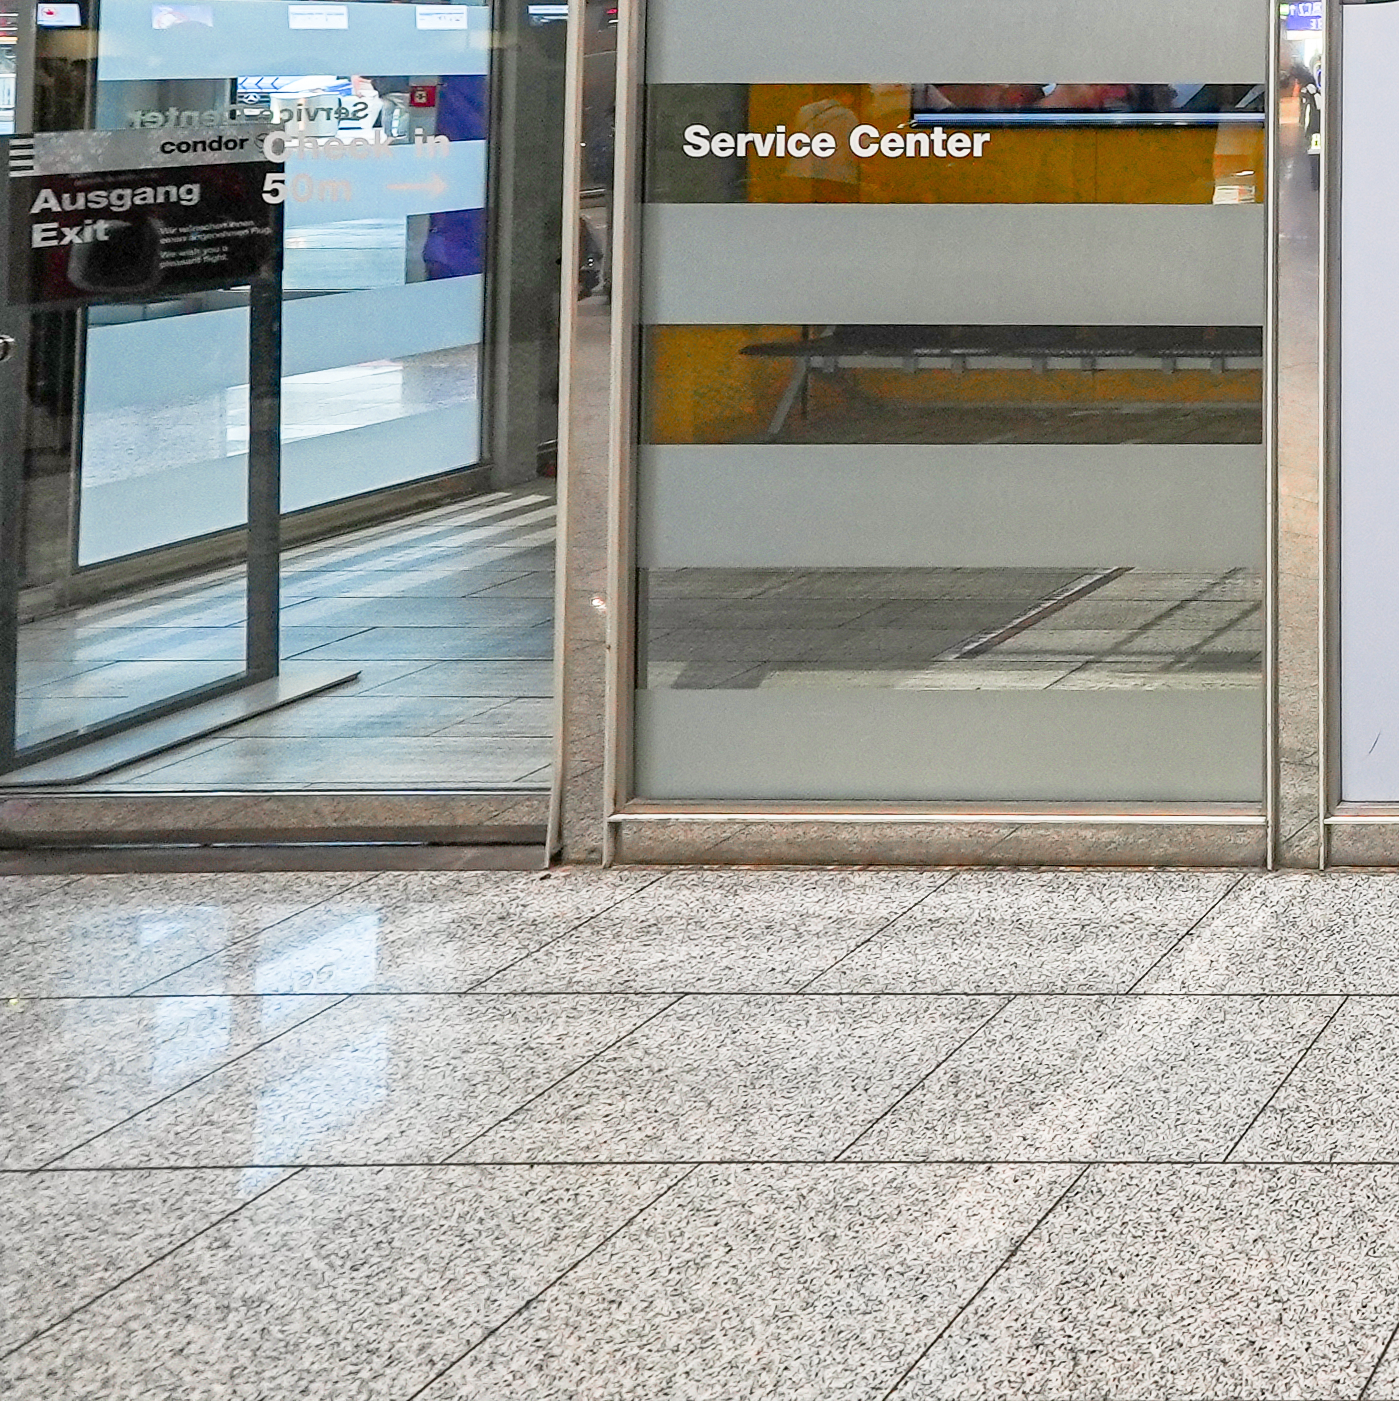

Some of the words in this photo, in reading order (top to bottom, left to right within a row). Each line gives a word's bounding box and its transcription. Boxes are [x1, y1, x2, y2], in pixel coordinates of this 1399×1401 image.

[160, 135, 250, 154] condor
[262, 128, 393, 164] Check
[414, 128, 451, 158] in
[683, 125, 836, 158] Service
[849, 124, 991, 158] Center
[30, 183, 201, 213] Ausgang
[262, 172, 352, 205] 50m
[31, 219, 110, 248] Exit
